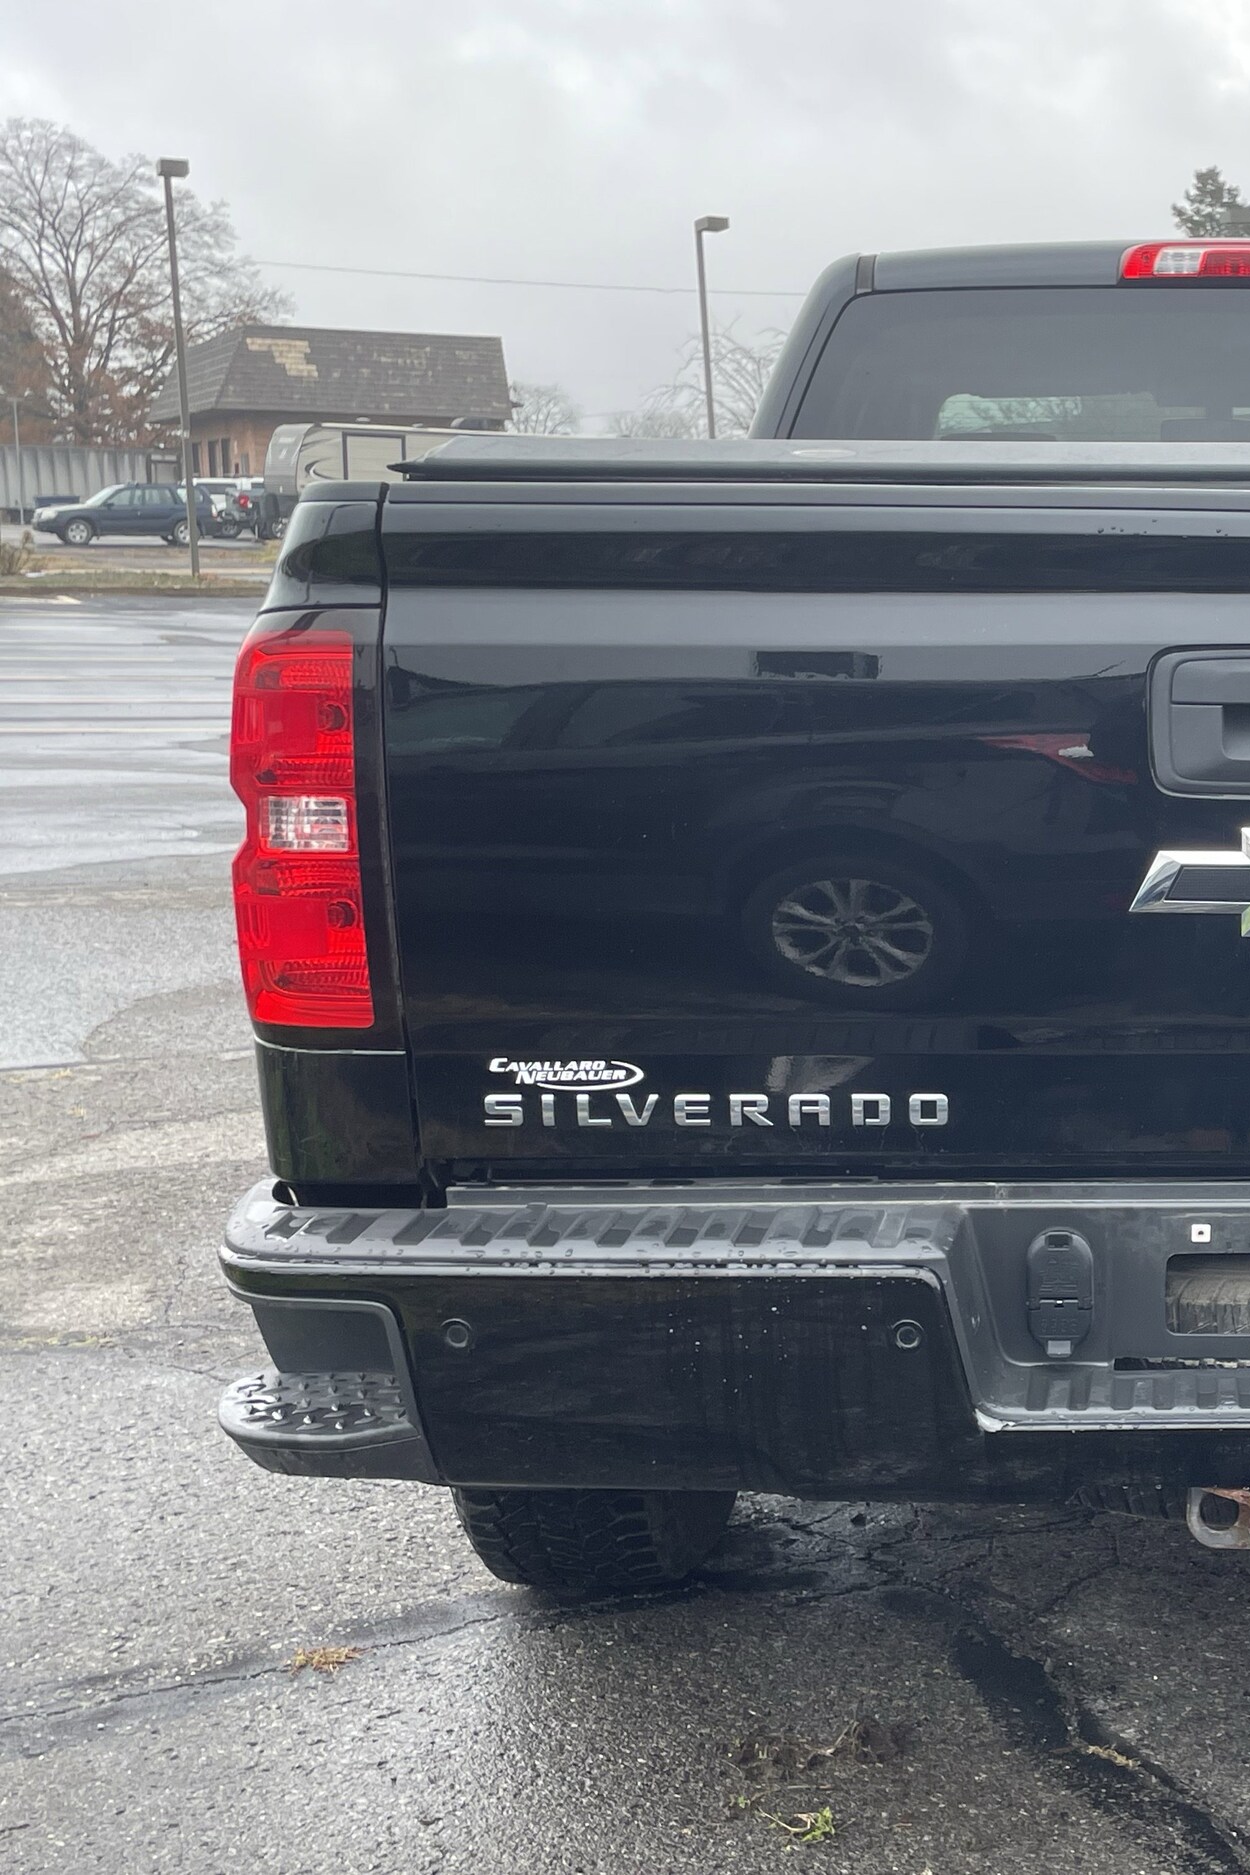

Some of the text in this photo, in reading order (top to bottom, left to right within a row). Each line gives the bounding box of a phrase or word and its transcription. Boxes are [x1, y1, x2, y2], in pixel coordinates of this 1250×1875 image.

[489, 1057, 606, 1073] CAVALLARO
[515, 1070, 627, 1085] NEUBAUER
[484, 1093, 949, 1127] SILVERADO
